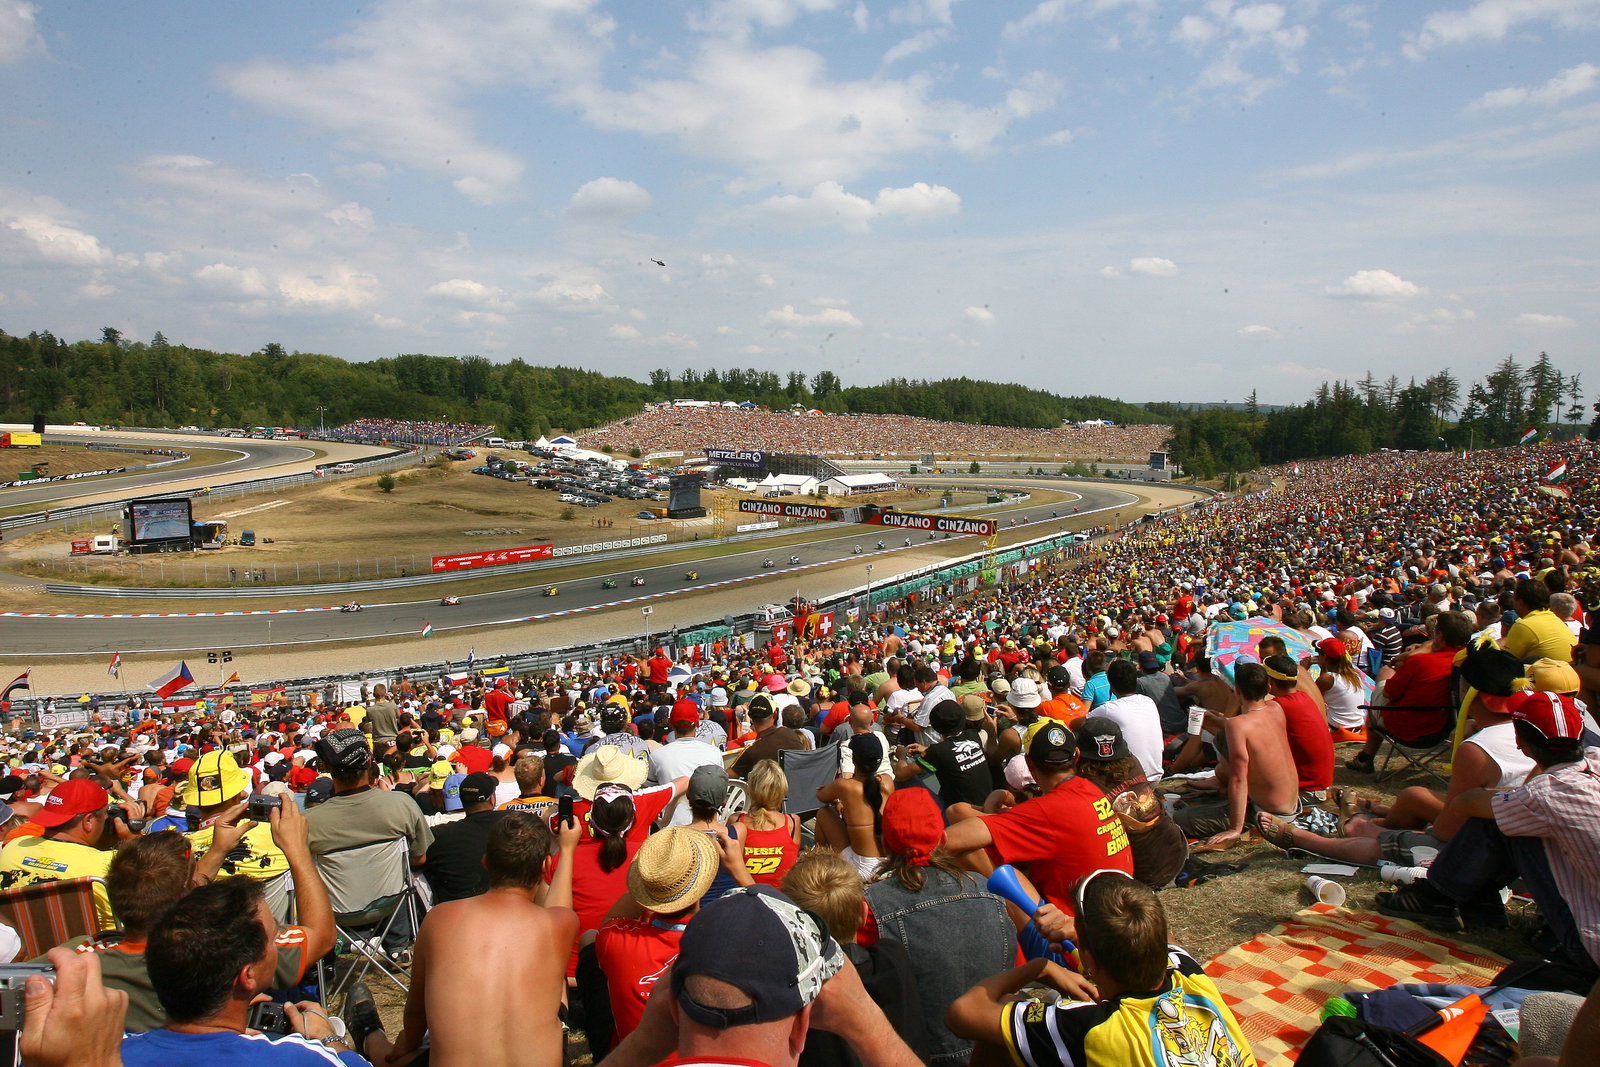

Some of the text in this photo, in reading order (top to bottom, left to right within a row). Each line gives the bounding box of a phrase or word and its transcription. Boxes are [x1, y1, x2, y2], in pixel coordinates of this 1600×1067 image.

[708, 450, 752, 460] METZELER
[741, 501, 781, 514] CINZANO
[785, 505, 827, 518] CINZANO
[883, 514, 931, 528] CINZANO
[937, 519, 988, 534] CINZANO
[1092, 796, 1115, 821] 52
[1096, 821, 1116, 836] GRAND
[1106, 831, 1130, 856] BRN
[744, 846, 784, 856] PESEK
[746, 857, 782, 875] 52
